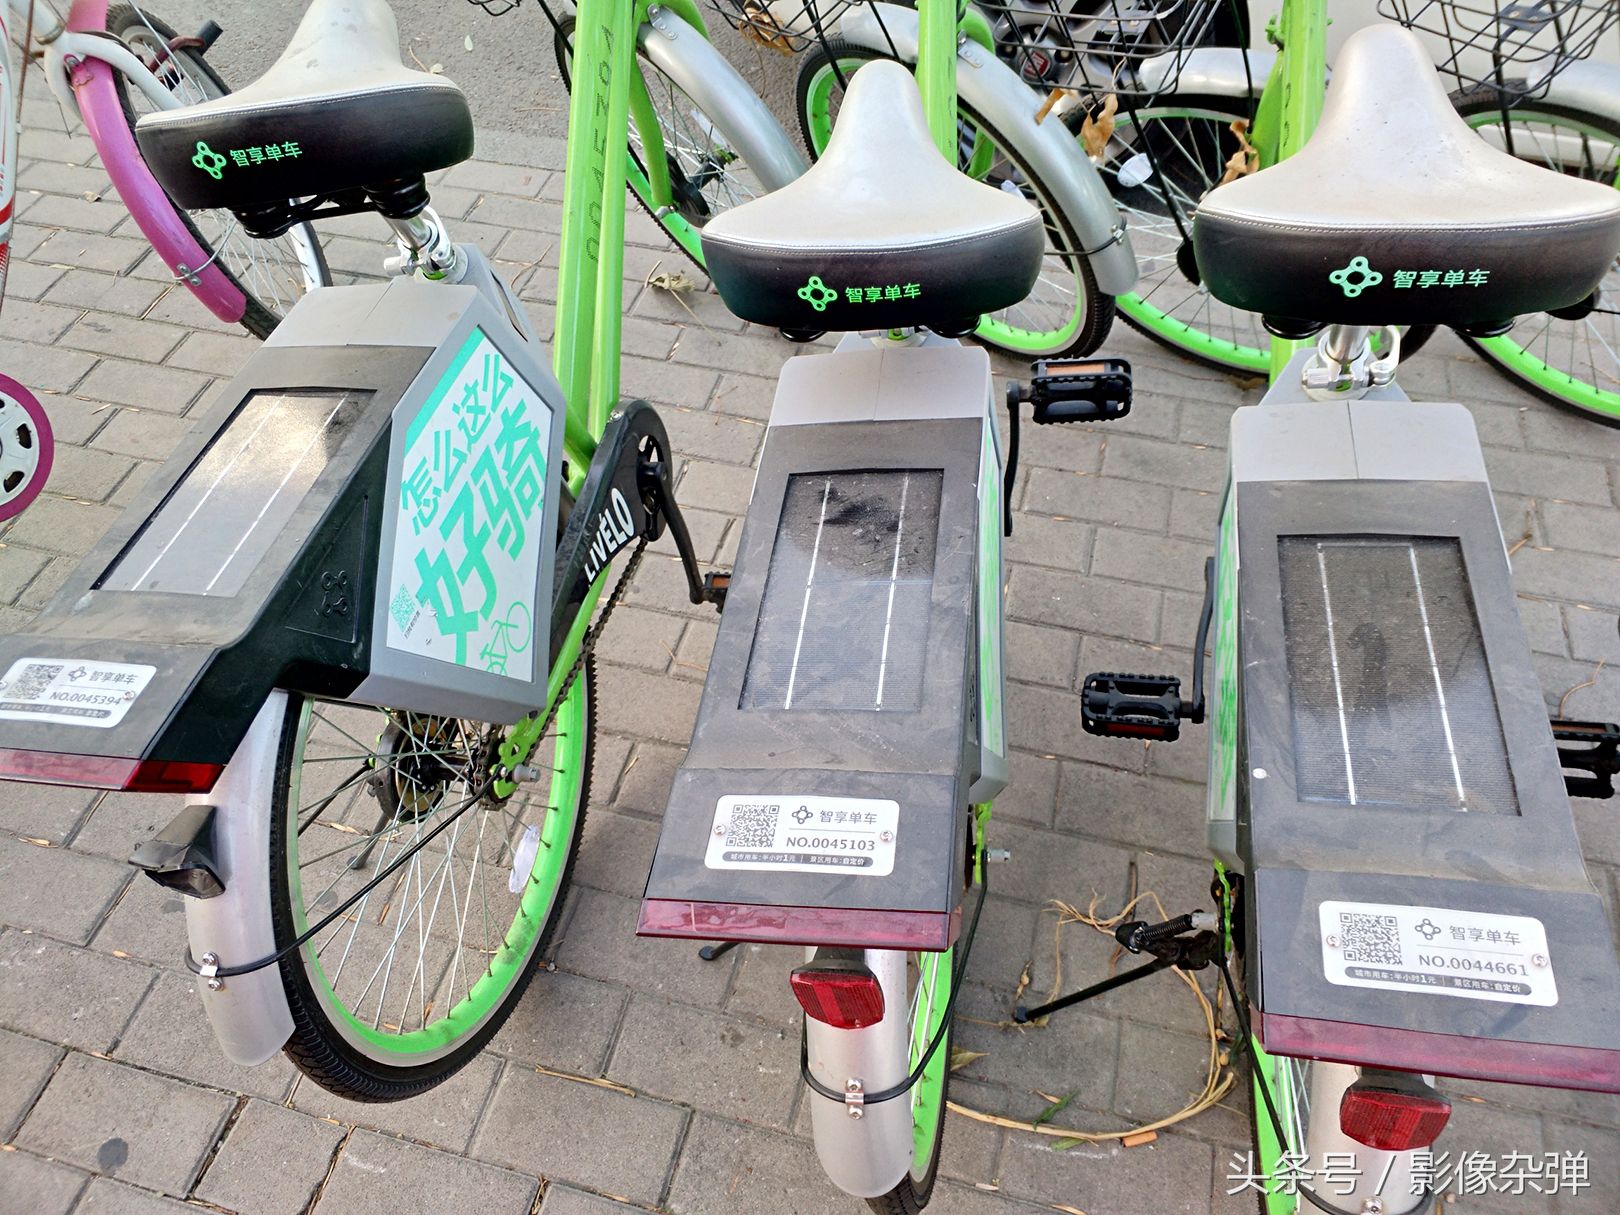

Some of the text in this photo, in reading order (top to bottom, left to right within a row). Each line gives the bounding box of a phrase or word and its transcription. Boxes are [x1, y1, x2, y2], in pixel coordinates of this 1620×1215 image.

[230, 141, 302, 167] 智享单车
[1392, 268, 1491, 290] 智享单车
[845, 282, 921, 304] 智享单车
[401, 353, 514, 536] 怎么这么
[415, 399, 547, 666] 好骑
[89, 670, 138, 684] 智享单车
[50, 691, 122, 705] NO.0045394
[819, 810, 878, 825] 智享单车
[786, 836, 875, 851] NO.0045103
[1449, 924, 1521, 946] 智享单车
[1418, 954, 1529, 976] NO.0044661
